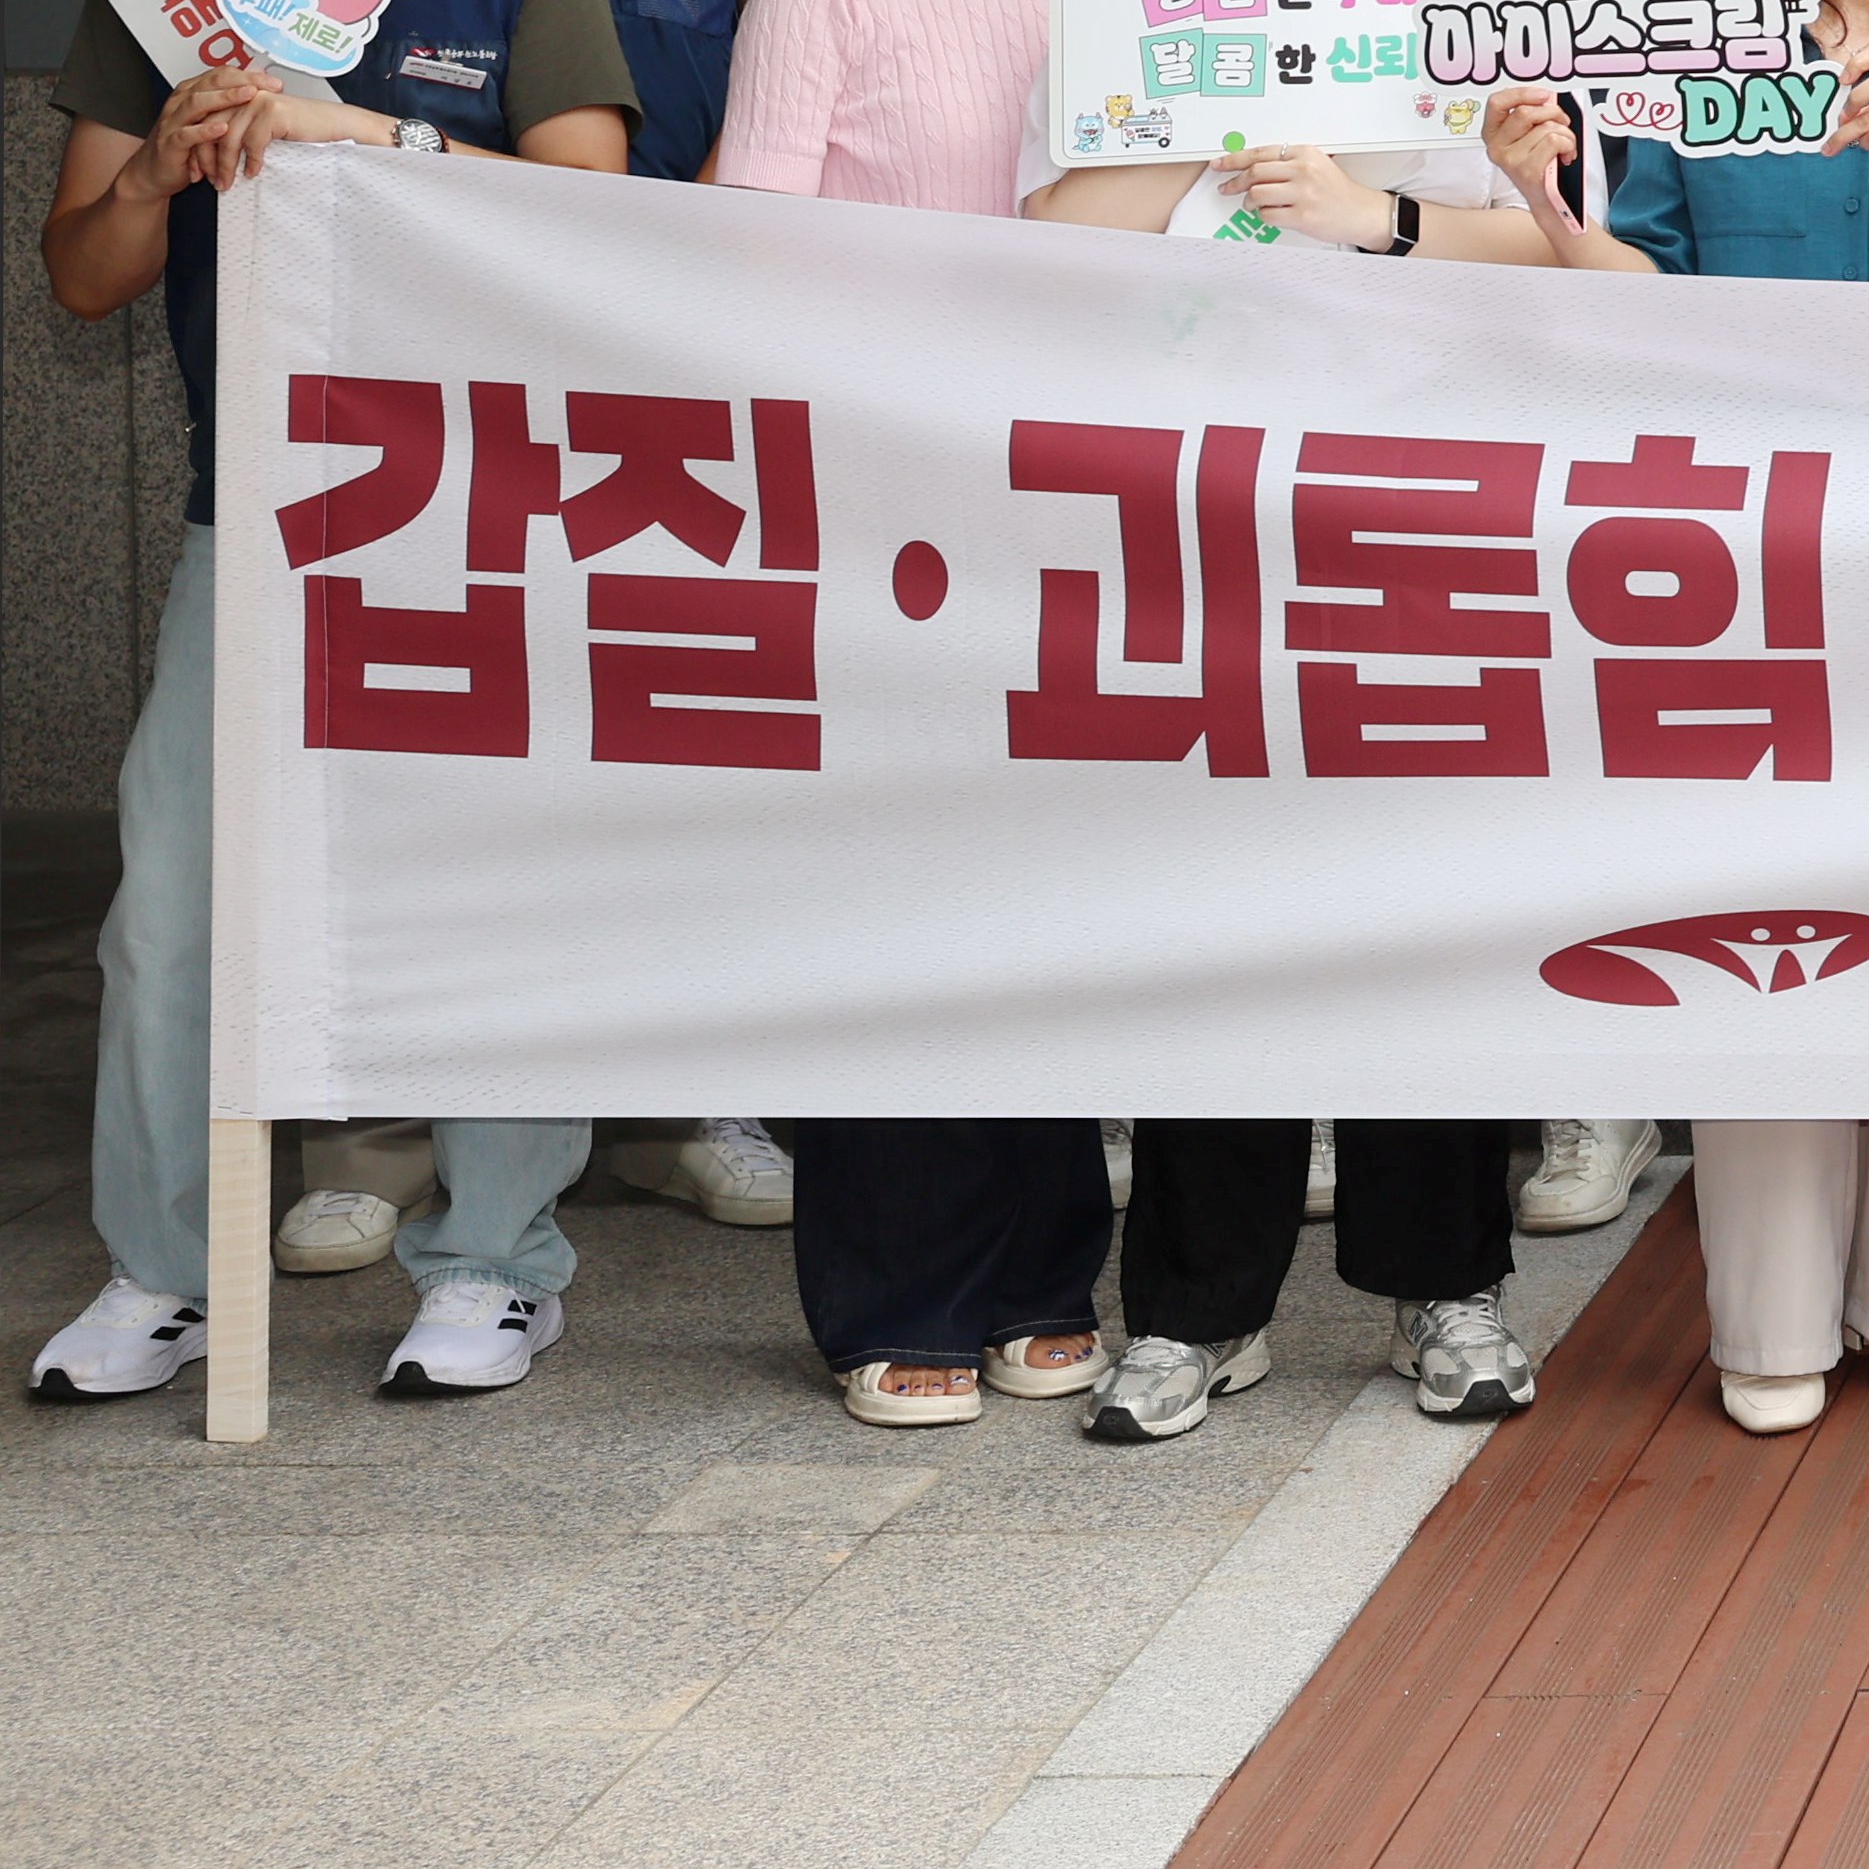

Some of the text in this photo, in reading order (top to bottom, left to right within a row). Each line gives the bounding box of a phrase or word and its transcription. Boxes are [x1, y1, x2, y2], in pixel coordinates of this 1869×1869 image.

[288, 13, 354, 54] 제로!
[1150, 32, 1419, 87] 달콤한 신뢰
[1676, 70, 1839, 148] DAY
